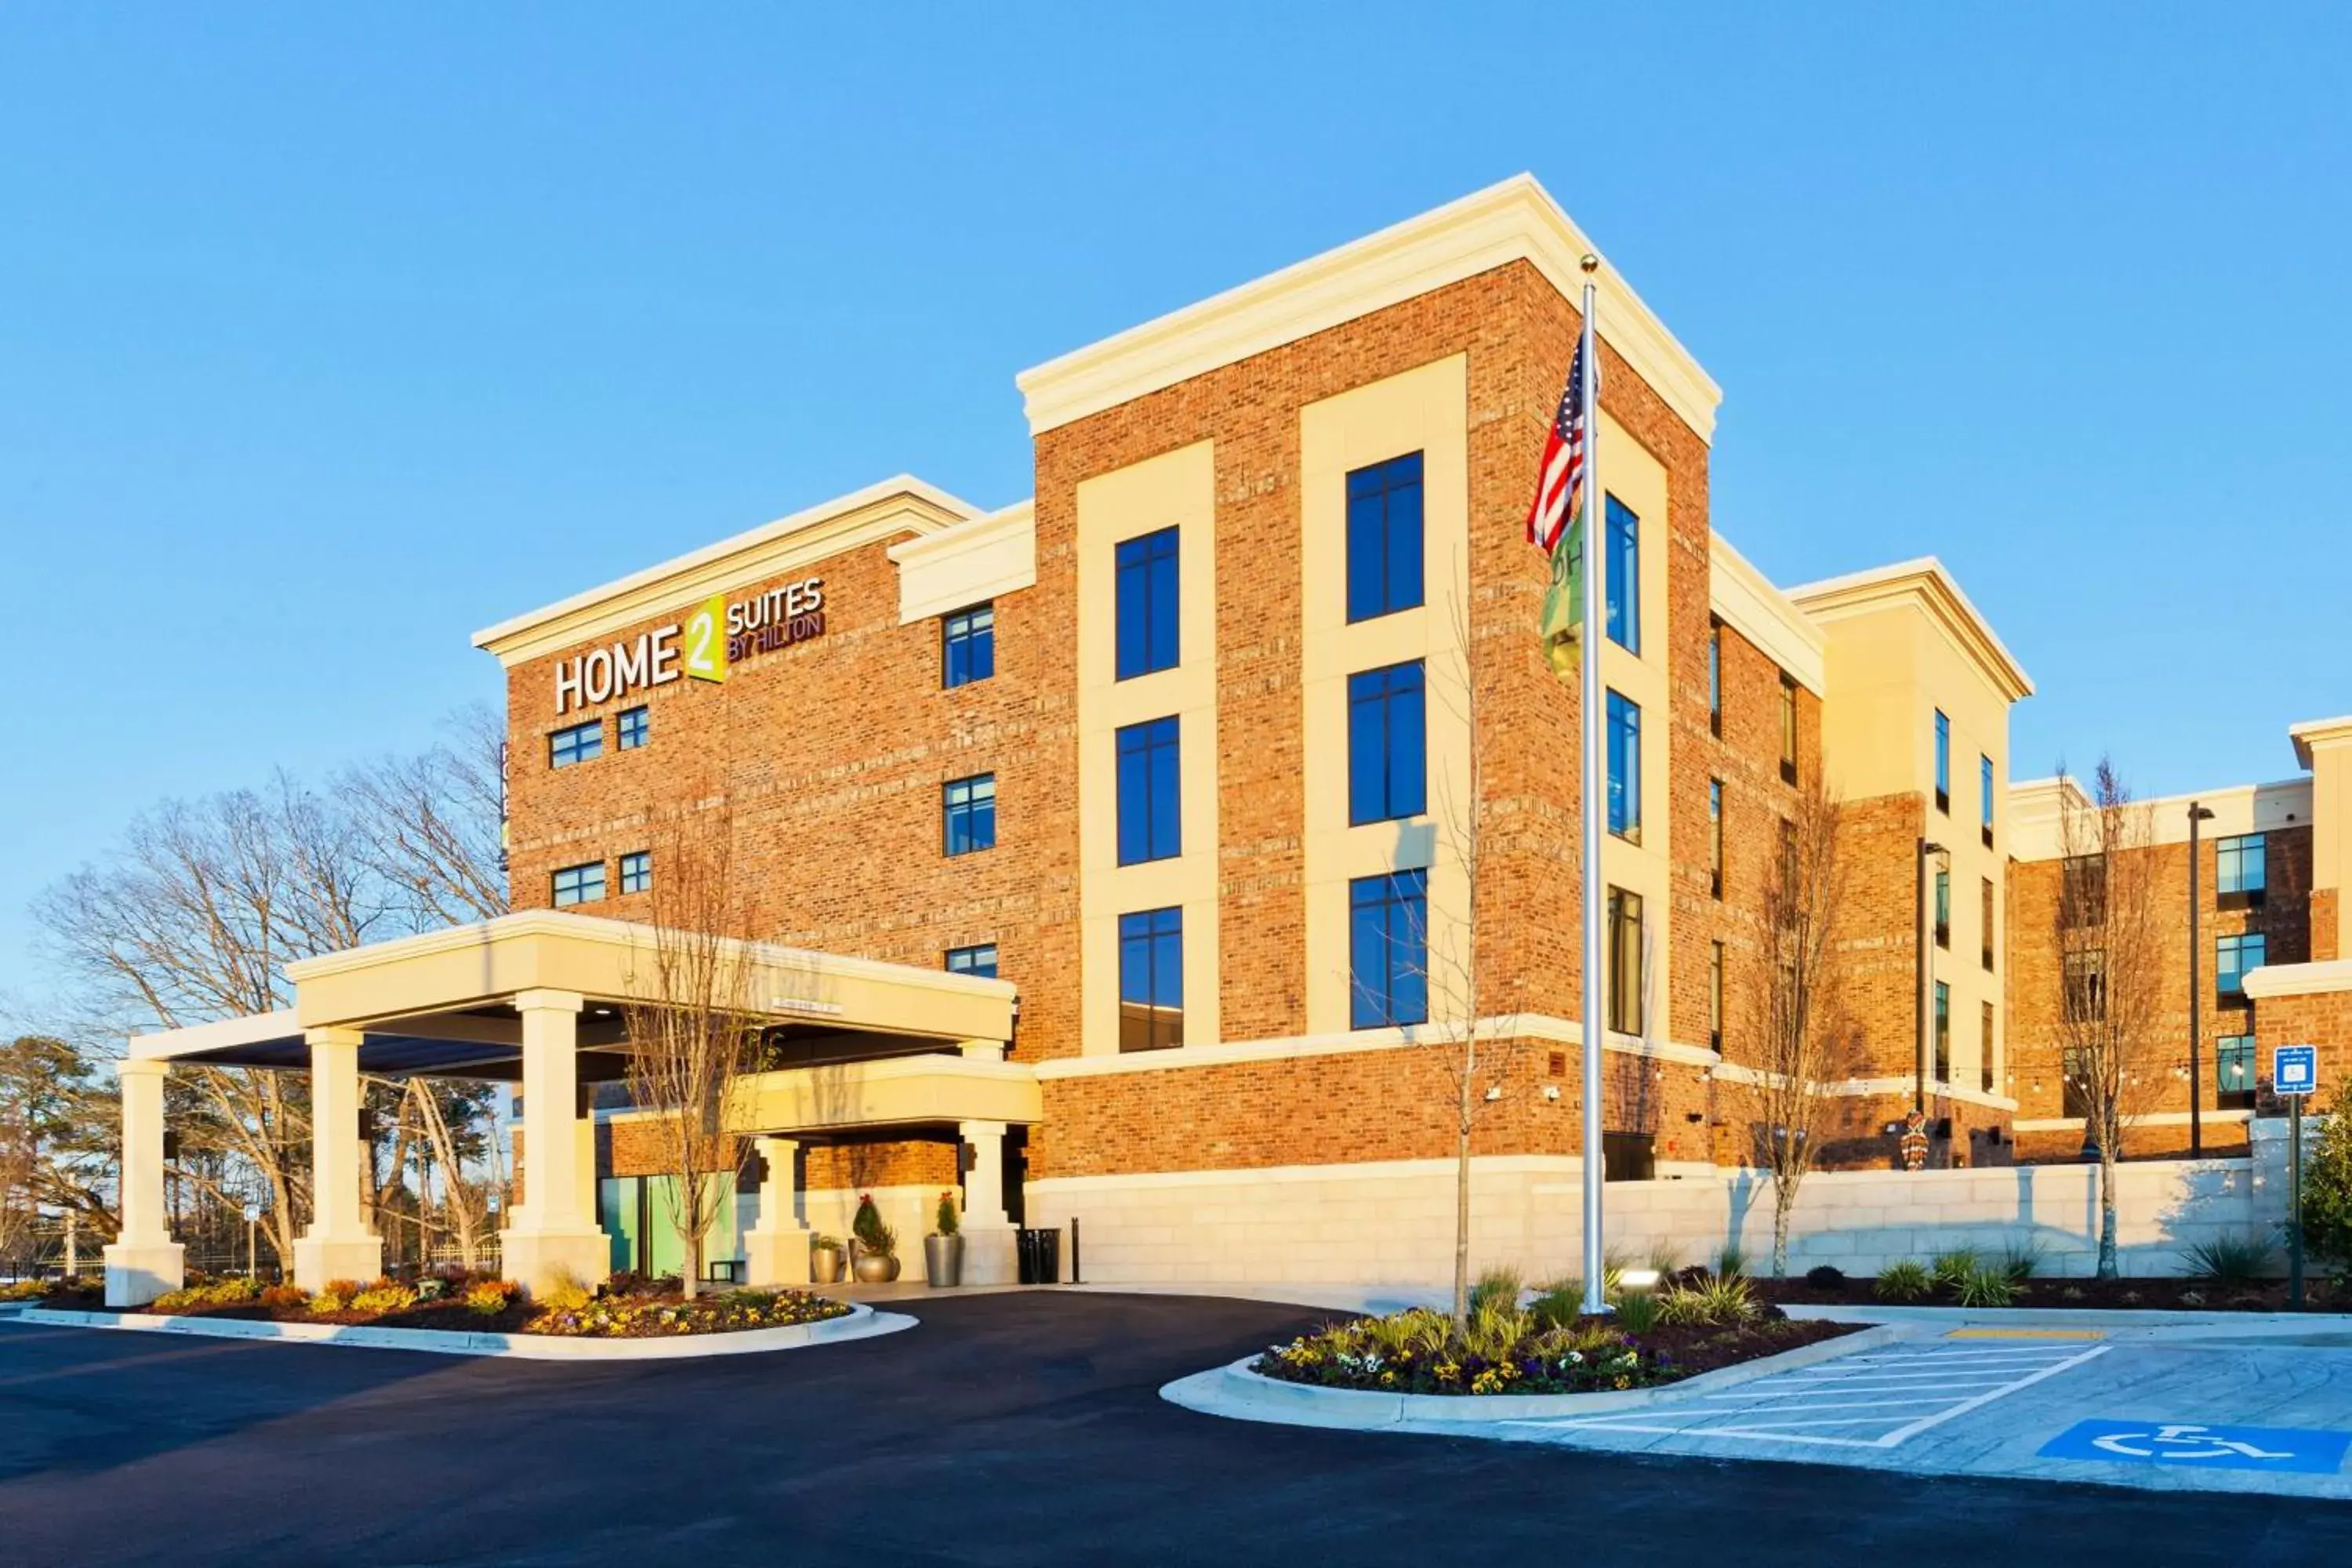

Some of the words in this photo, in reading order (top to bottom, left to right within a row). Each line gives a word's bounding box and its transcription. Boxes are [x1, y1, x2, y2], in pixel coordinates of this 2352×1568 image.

[555, 624, 679, 714] HOME
[688, 612, 713, 671] 2
[727, 577, 822, 636] SUITES
[728, 633, 750, 661] BY
[753, 612, 821, 652] HILTON
